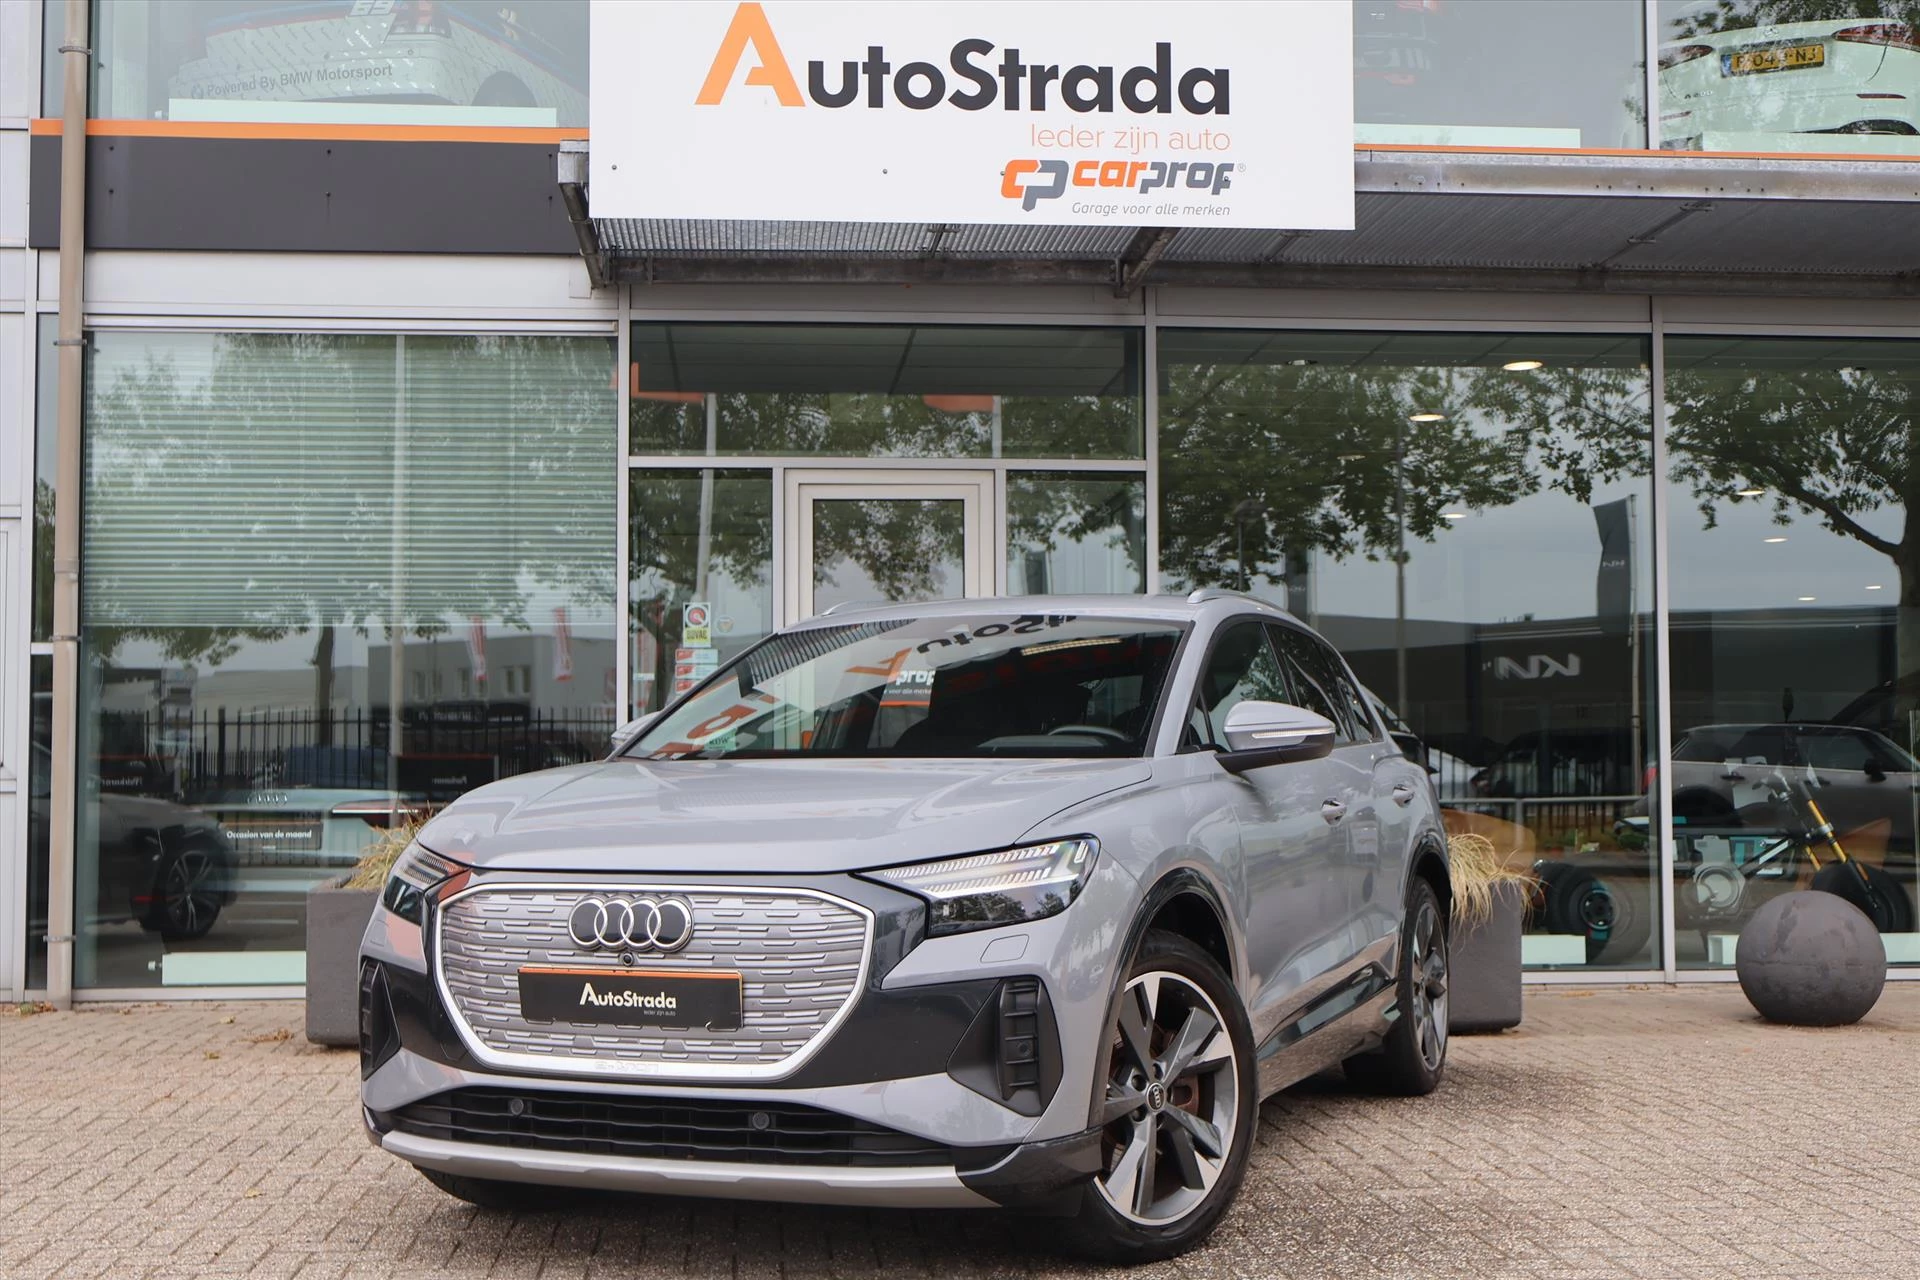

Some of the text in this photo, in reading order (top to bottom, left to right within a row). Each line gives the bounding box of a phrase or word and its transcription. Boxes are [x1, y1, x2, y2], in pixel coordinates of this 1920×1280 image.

[693, 2, 1230, 115] AutoStrada
[207, 64, 393, 97] Powered By BMW Motorsport
[1031, 123, 1231, 155] Ieder zijn auto
[1072, 160, 1235, 195] carprof
[1072, 202, 1231, 217] Garage voor alle merken
[226, 829, 312, 839] Occasion van de maand
[579, 982, 677, 1009] AutoStrada
